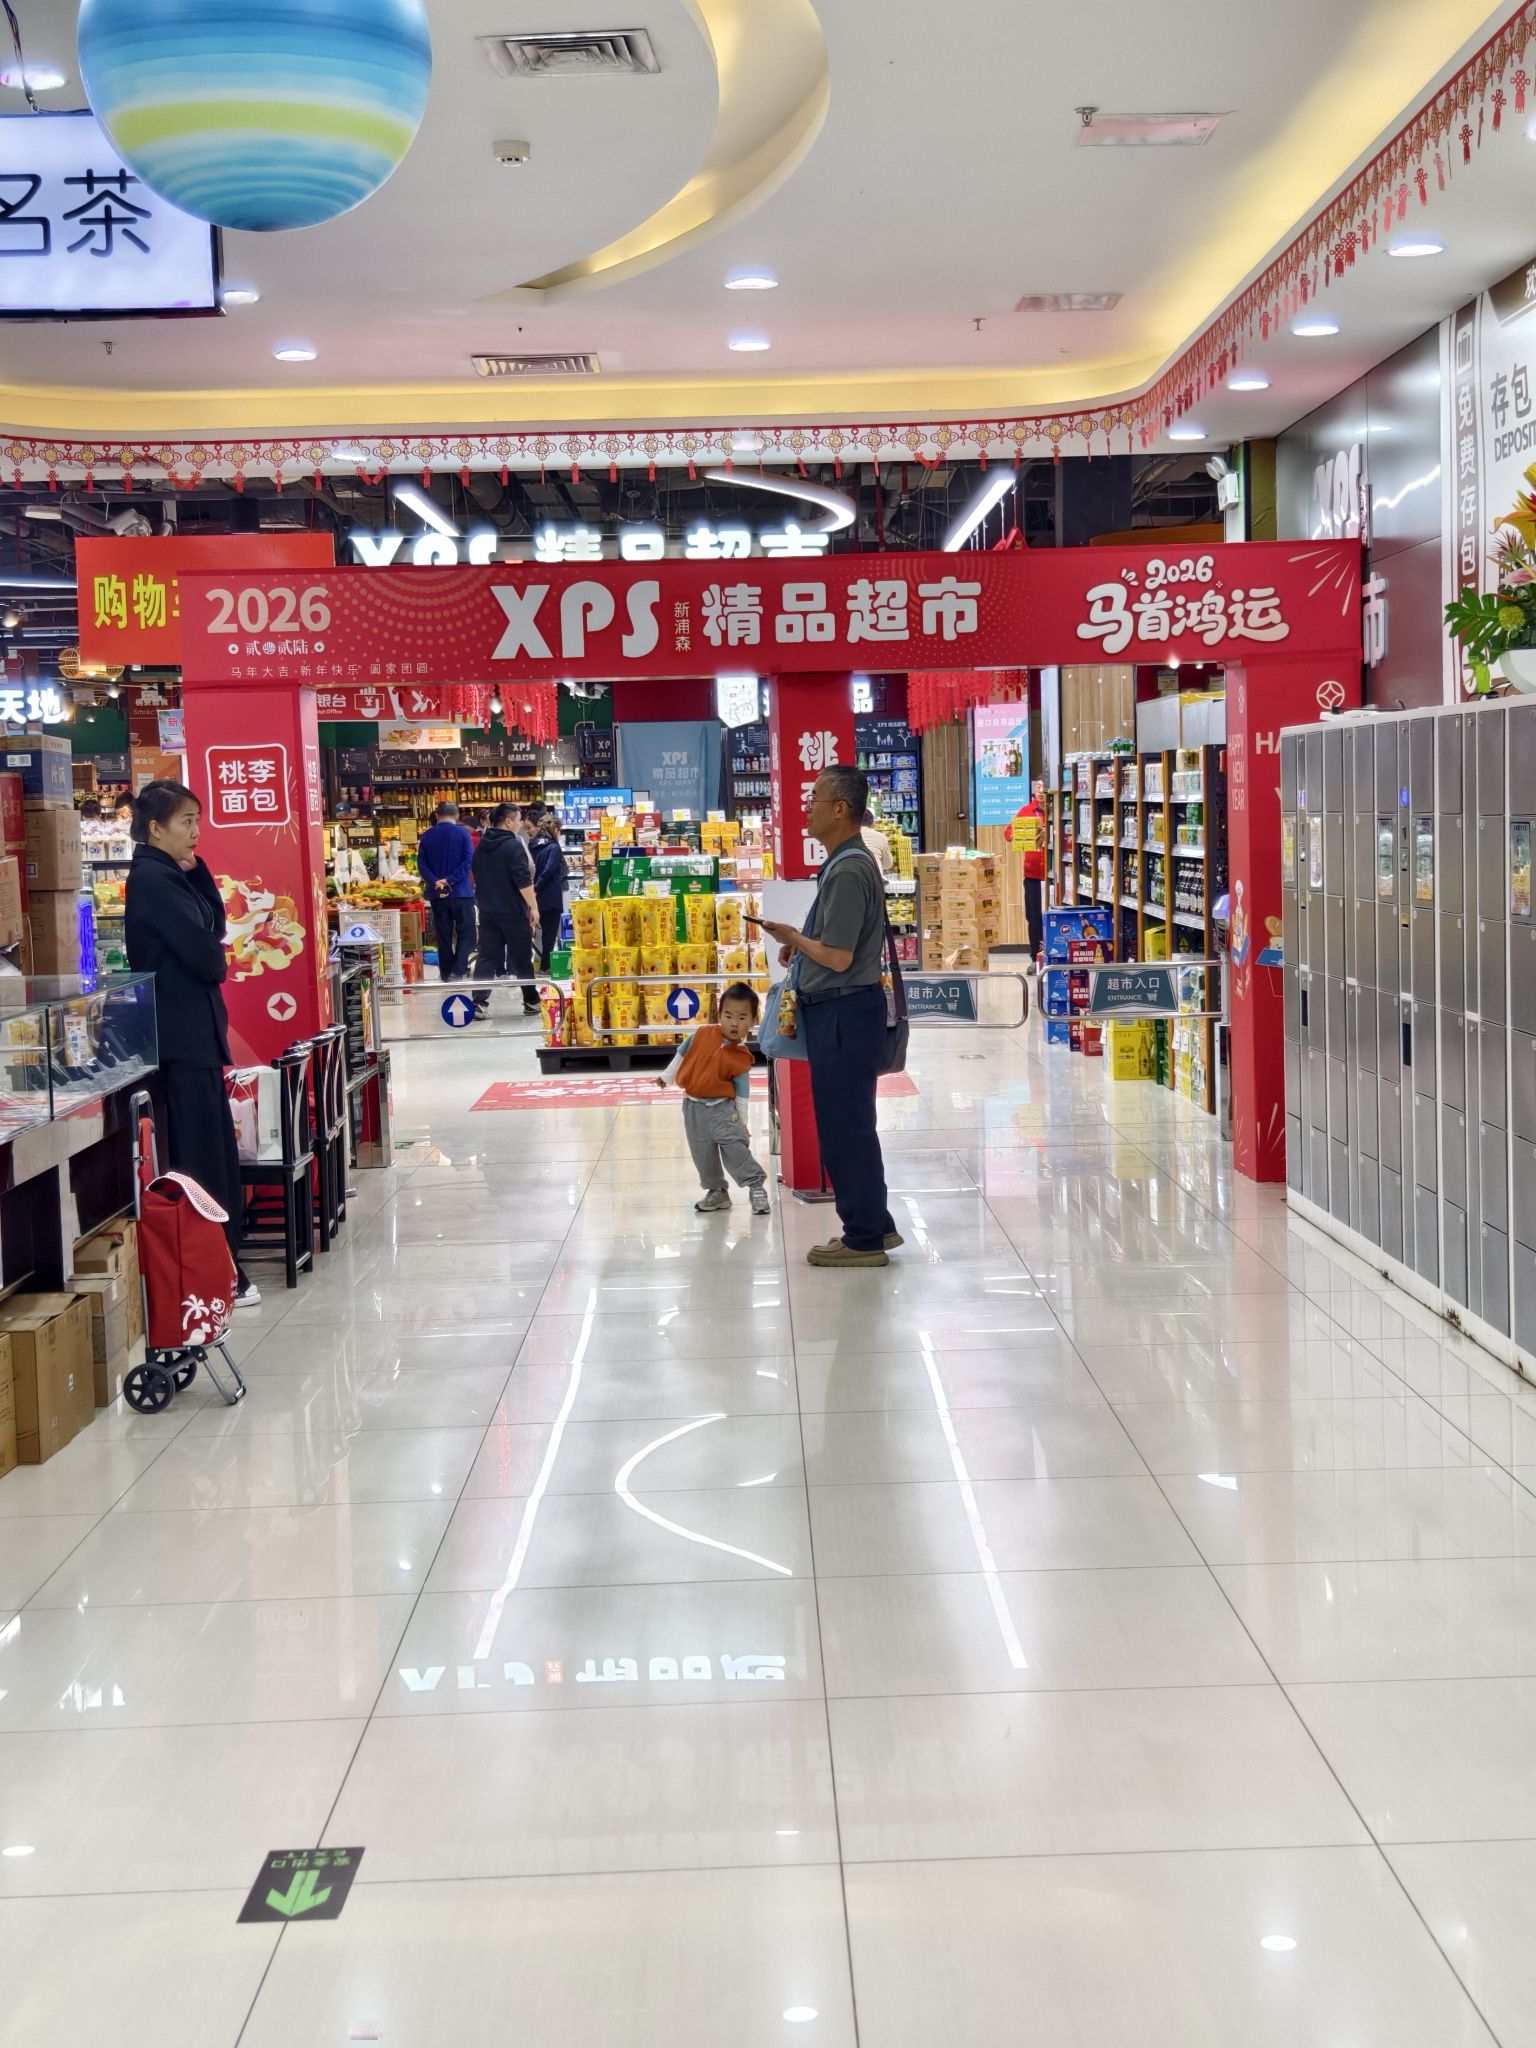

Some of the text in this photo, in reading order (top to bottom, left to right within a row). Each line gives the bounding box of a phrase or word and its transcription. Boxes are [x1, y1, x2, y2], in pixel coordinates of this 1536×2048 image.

[0, 168, 153, 257] 名茶
[1490, 363, 1532, 430] 存包
[1494, 420, 1536, 462] DEPOSIT
[1458, 384, 1476, 590] 免费存包
[1145, 555, 1214, 589] 2026
[94, 574, 180, 630] 购物
[205, 587, 331, 634] 2026
[490, 580, 660, 660] XPS
[701, 576, 981, 647] 精品超市
[1076, 582, 1290, 654] 马首鸿运
[673, 601, 691, 652] 新浦森
[231, 666, 289, 678] 马年大吉
[300, 663, 359, 677] 新年快乐
[0, 688, 66, 725] 天地
[219, 759, 277, 785] 桃李
[220, 787, 279, 814] 面包
[908, 986, 960, 1000] 超市入口
[1107, 977, 1160, 991] 超市入口
